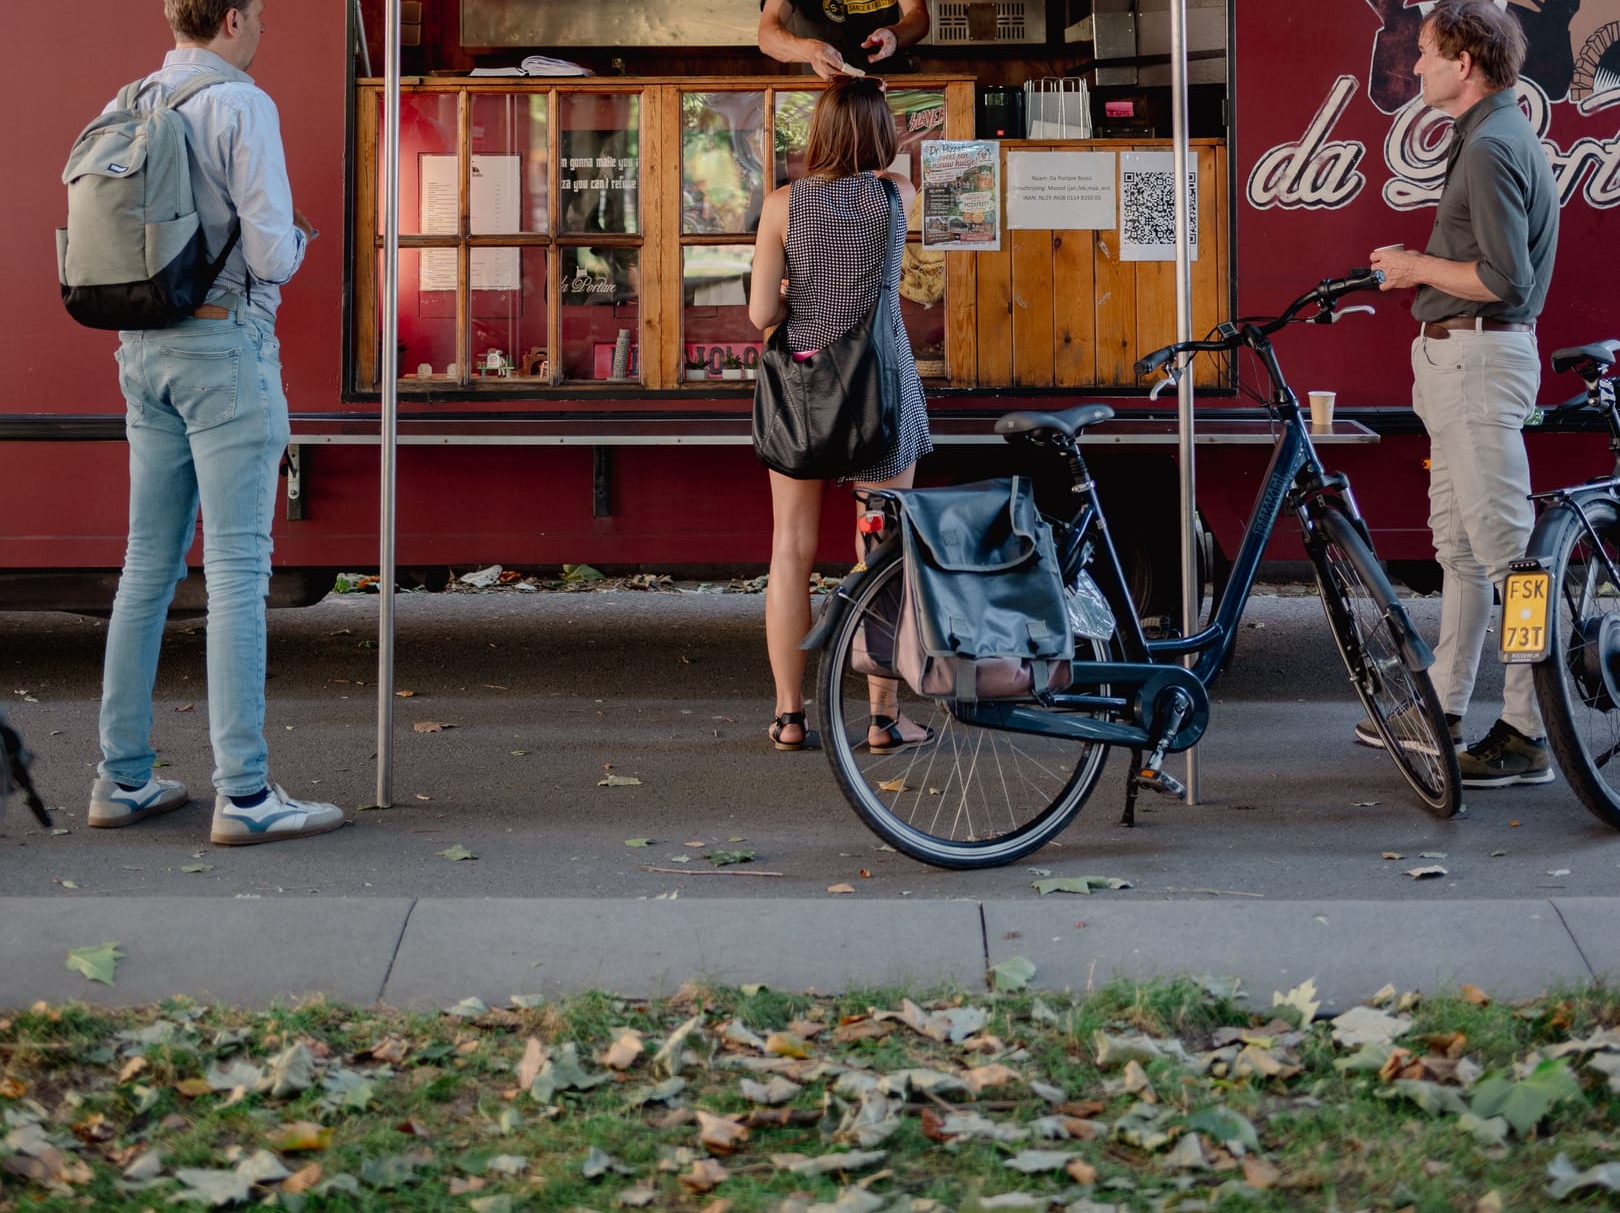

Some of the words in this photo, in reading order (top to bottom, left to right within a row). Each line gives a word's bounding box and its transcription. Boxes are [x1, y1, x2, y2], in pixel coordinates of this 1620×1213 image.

[1247, 75, 1366, 210] da
[570, 158, 594, 171] gonna
[595, 155, 617, 168] make
[618, 158, 632, 171] you
[573, 180, 589, 193] you
[1510, 579, 1545, 600] FSK
[1507, 626, 1543, 647] 73T
